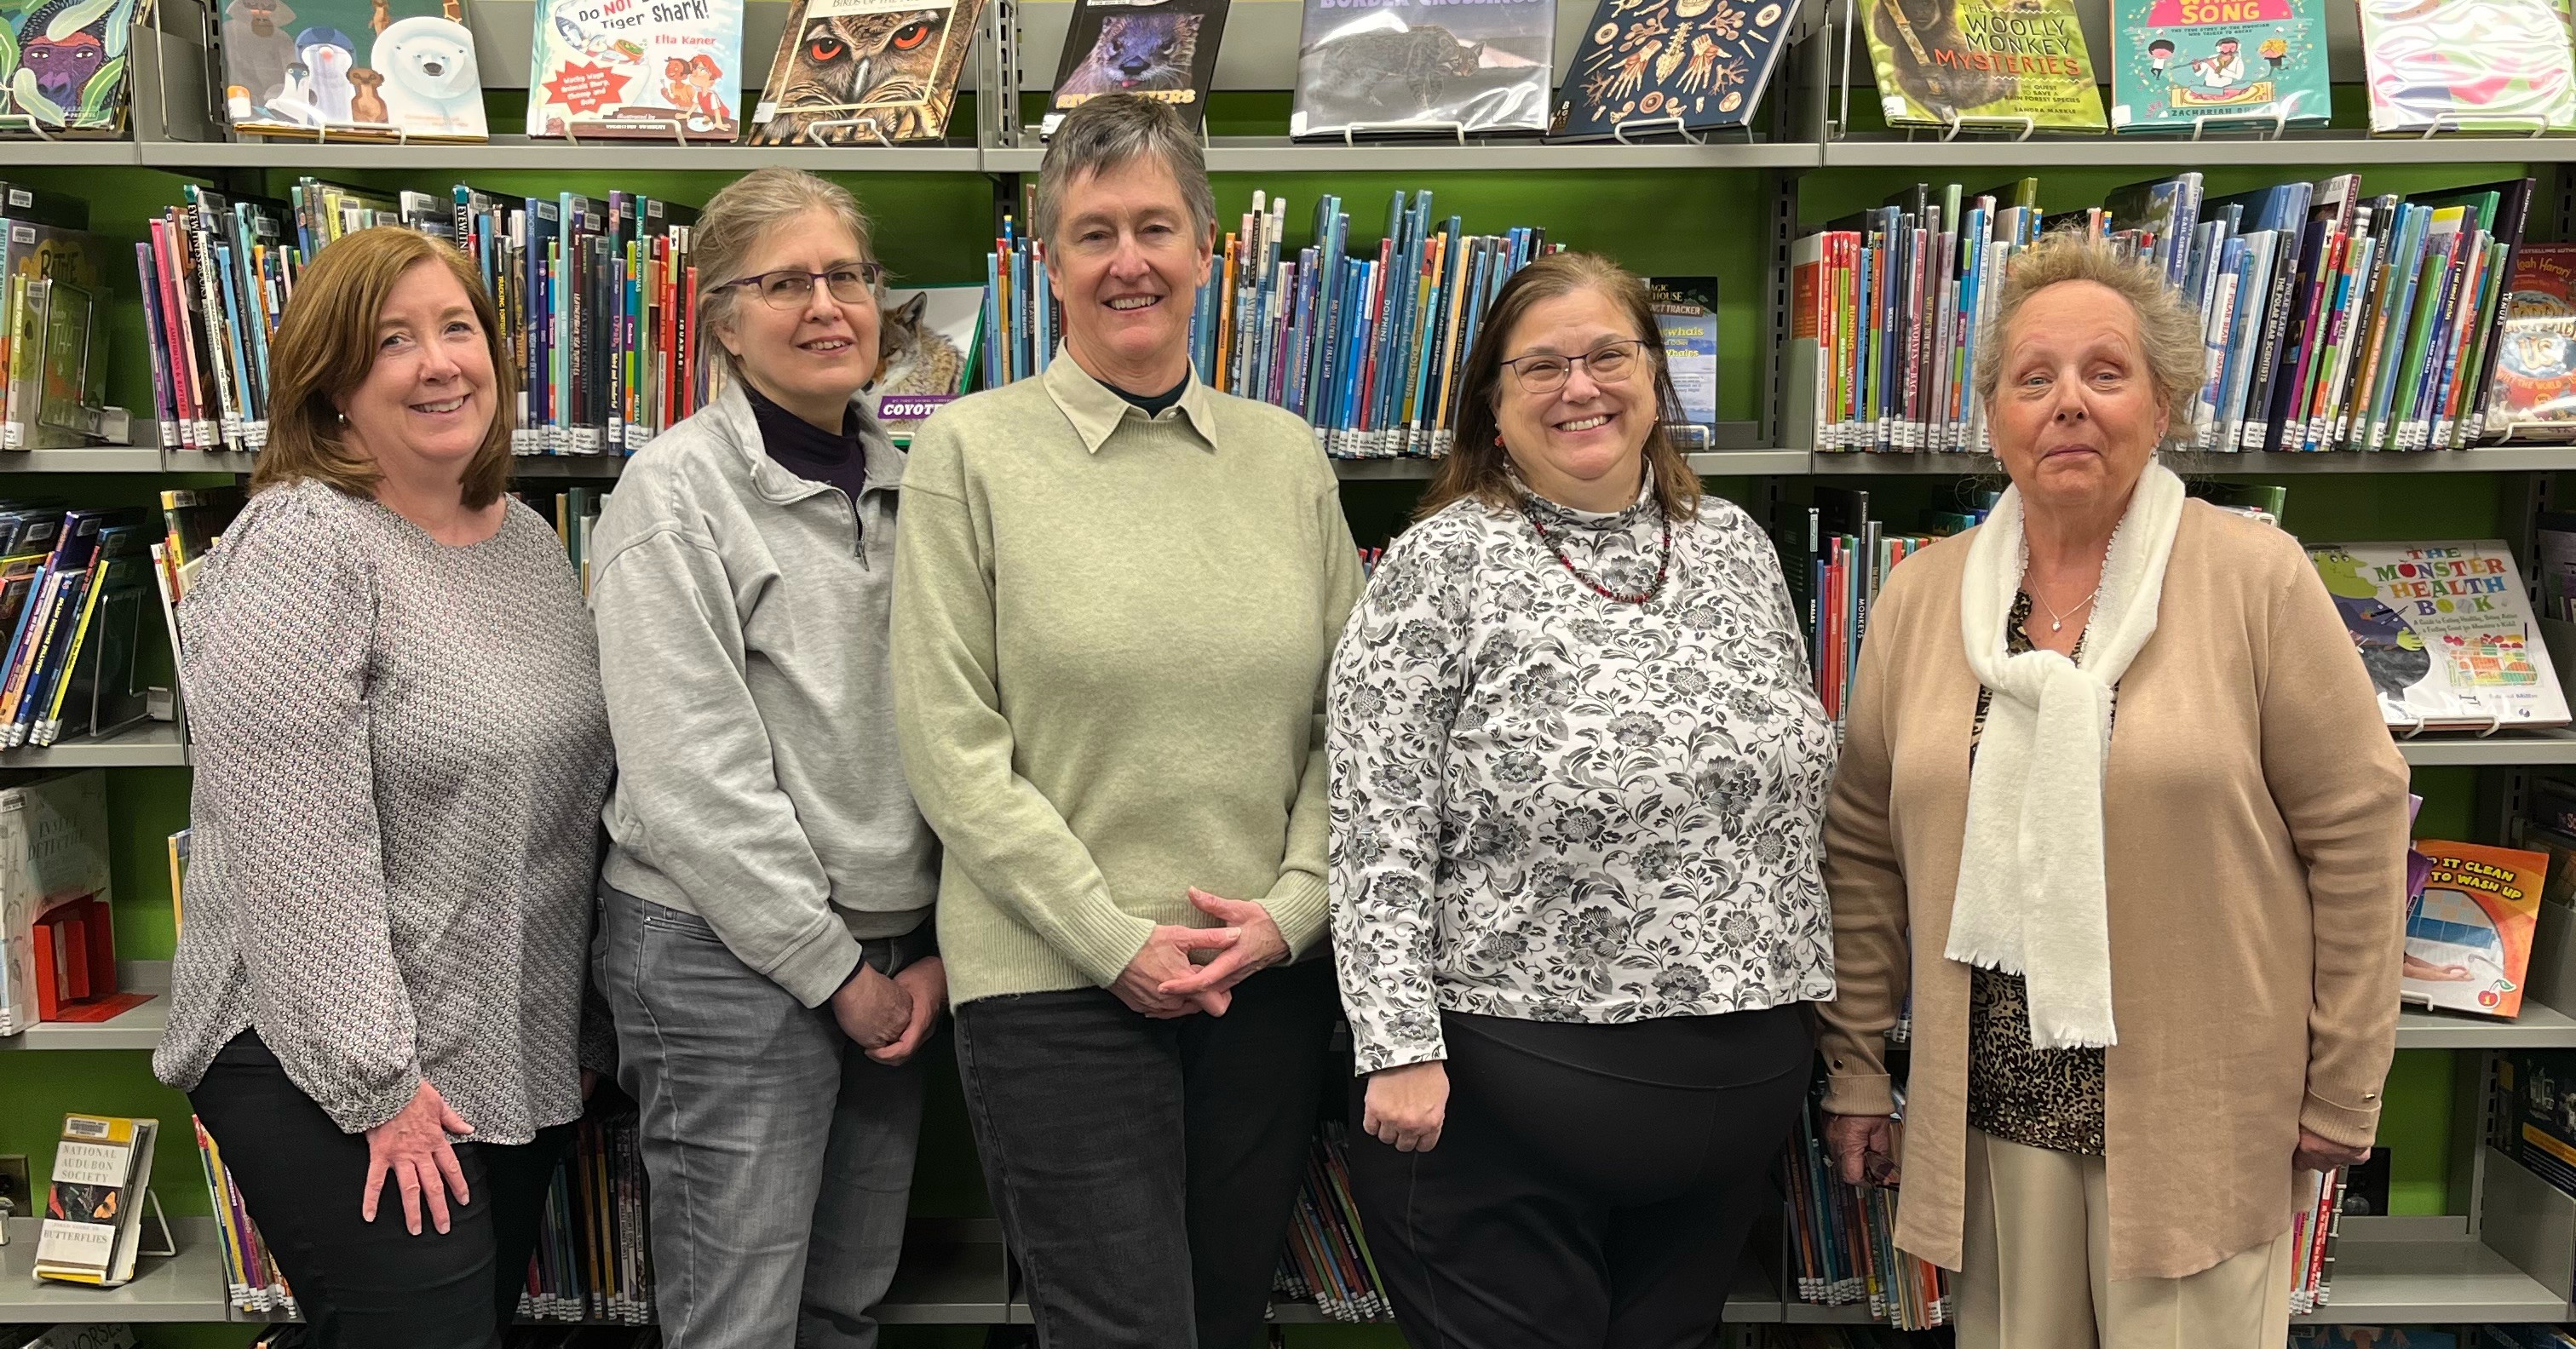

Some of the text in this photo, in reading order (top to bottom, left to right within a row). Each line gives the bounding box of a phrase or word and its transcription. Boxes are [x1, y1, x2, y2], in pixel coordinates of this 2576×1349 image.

[579, 0, 633, 22] Do NOT
[601, 0, 710, 29] Tiger Shark!
[2181, 3, 2260, 25] SONG
[1964, 14, 2066, 36] WOOLLY
[655, 34, 717, 45] Ella Kaner
[1965, 33, 2071, 55] MONKEY
[1934, 48, 2082, 76] MYSTERIES
[2171, 107, 2232, 117] ZACHARIAH
[2343, 178, 2358, 218] CREATURES
[187, 204, 204, 263] EYEWITNESS
[1981, 232, 1990, 265] GRIZZLY
[1998, 249, 2007, 270] WILD
[2176, 236, 2186, 269] GIBBONS
[1979, 266, 1987, 286] BEAR
[1666, 305, 1700, 315] TRACKER
[2224, 293, 2234, 319] POLAR
[2276, 283, 2292, 337] POLAR BEARS
[2497, 292, 2509, 326] LEMURS
[1380, 300, 1390, 342] DOLPHINS
[2260, 277, 2286, 383] THE POLAR BEAR SCIENTISTS
[1911, 323, 1921, 359] WOLVES
[1845, 305, 1856, 405] RUNNING WOLVES
[1404, 346, 1419, 399] DOLPHINS
[1908, 372, 1918, 398] BACK
[2535, 380, 2562, 390] WORLD
[2406, 547, 2462, 560] THE
[2389, 576, 2508, 600] HEALTH
[2413, 595, 2495, 616] BOOK
[1856, 598, 1866, 640] MONKEYS
[2442, 857, 2515, 882] IT CLEAN
[2431, 871, 2522, 900] TO WASH UP
[61, 1158, 113, 1171] AUDUBON
[63, 1145, 118, 1159] NATIONAL
[60, 1170, 109, 1183] SOCIETY
[43, 1229, 108, 1244] BUTTERFLIES
